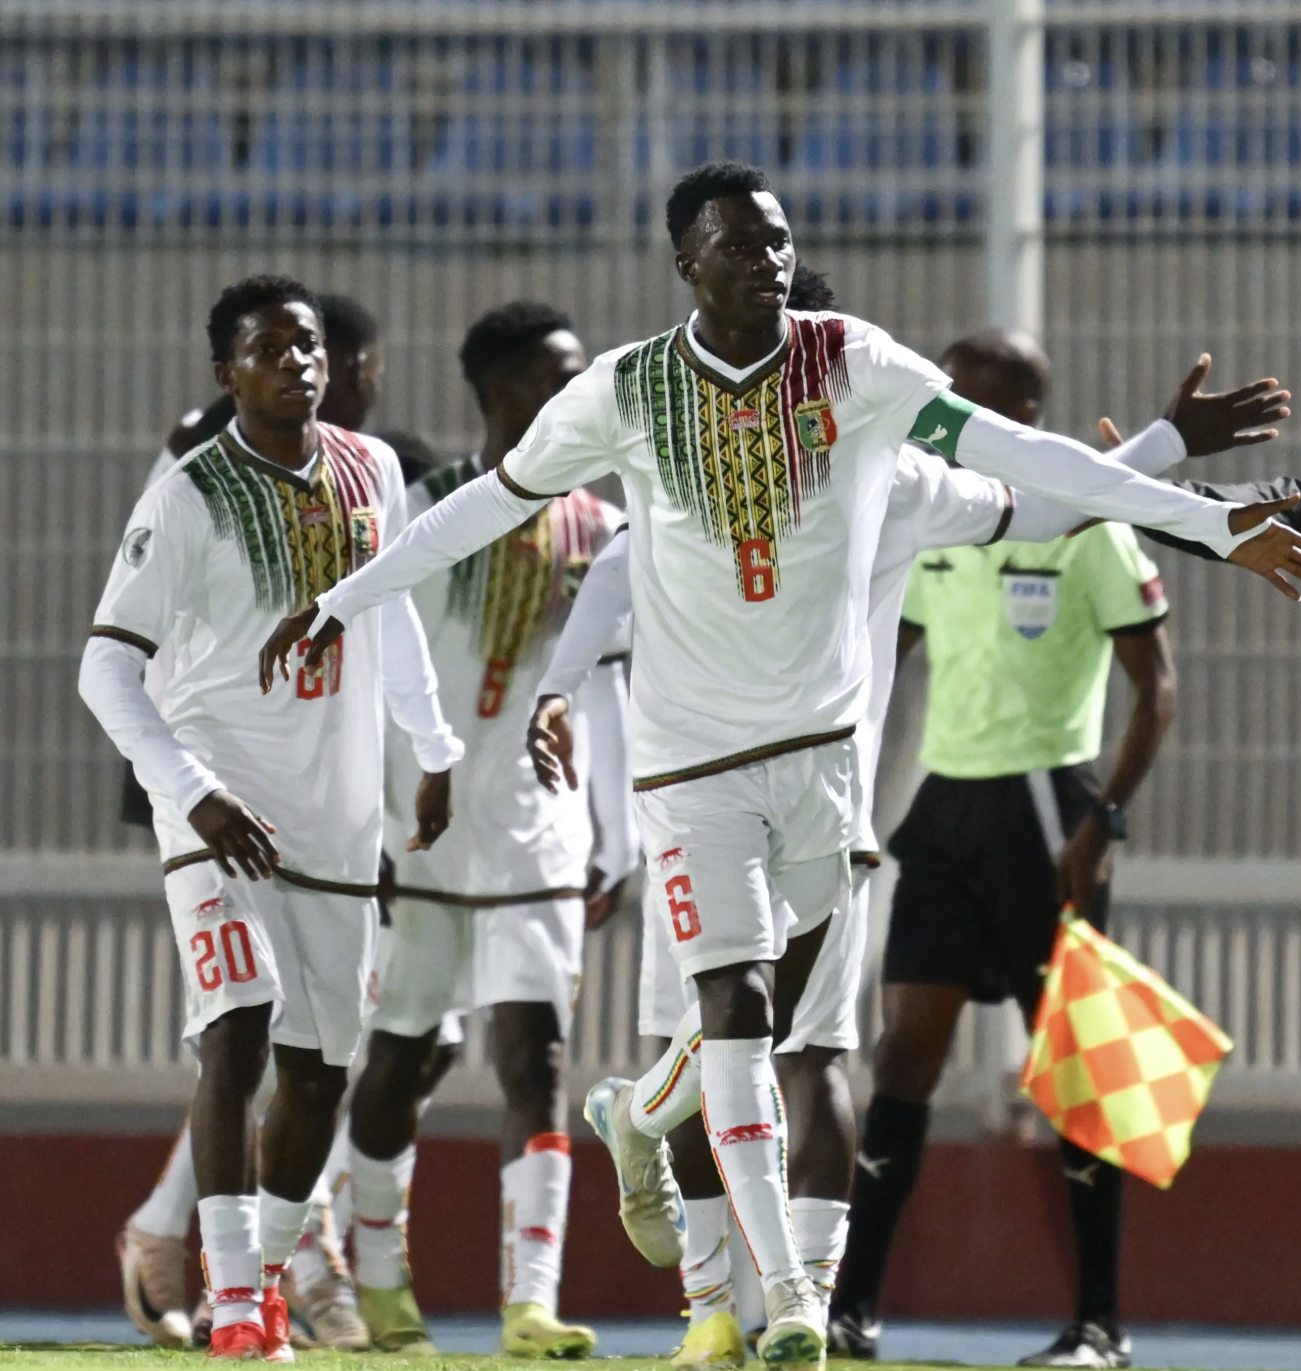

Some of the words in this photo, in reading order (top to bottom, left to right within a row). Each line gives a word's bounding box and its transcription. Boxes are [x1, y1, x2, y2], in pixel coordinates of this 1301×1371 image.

[740, 538, 775, 602] 6
[665, 875, 702, 942] 6
[190, 920, 258, 992] 20
